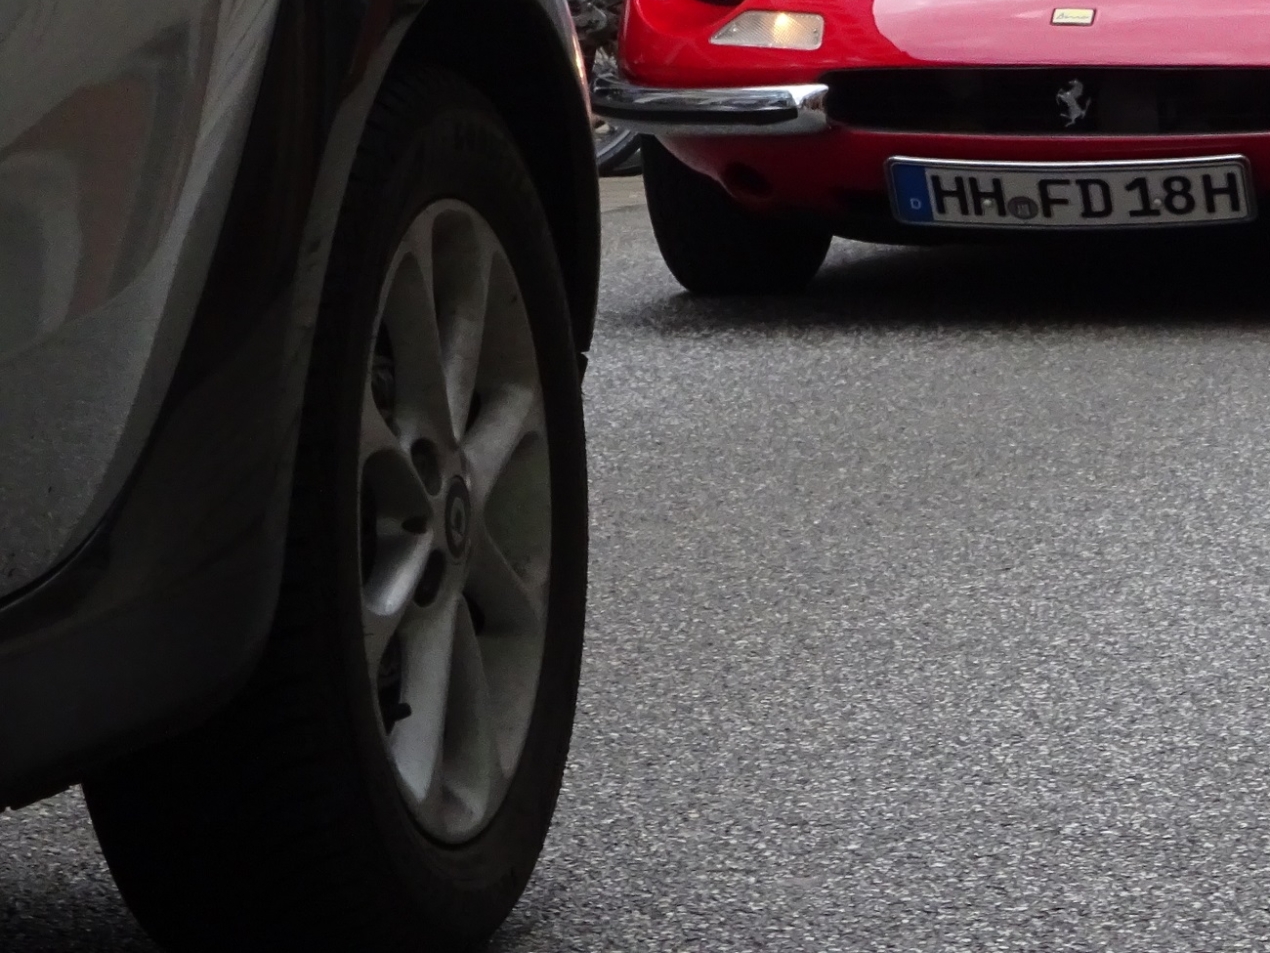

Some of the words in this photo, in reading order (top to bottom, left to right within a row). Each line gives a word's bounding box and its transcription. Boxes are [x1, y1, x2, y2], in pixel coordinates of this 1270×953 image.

[930, 174, 1007, 217] HH
[1036, 178, 1113, 218] FD
[1124, 172, 1242, 217] 18H
